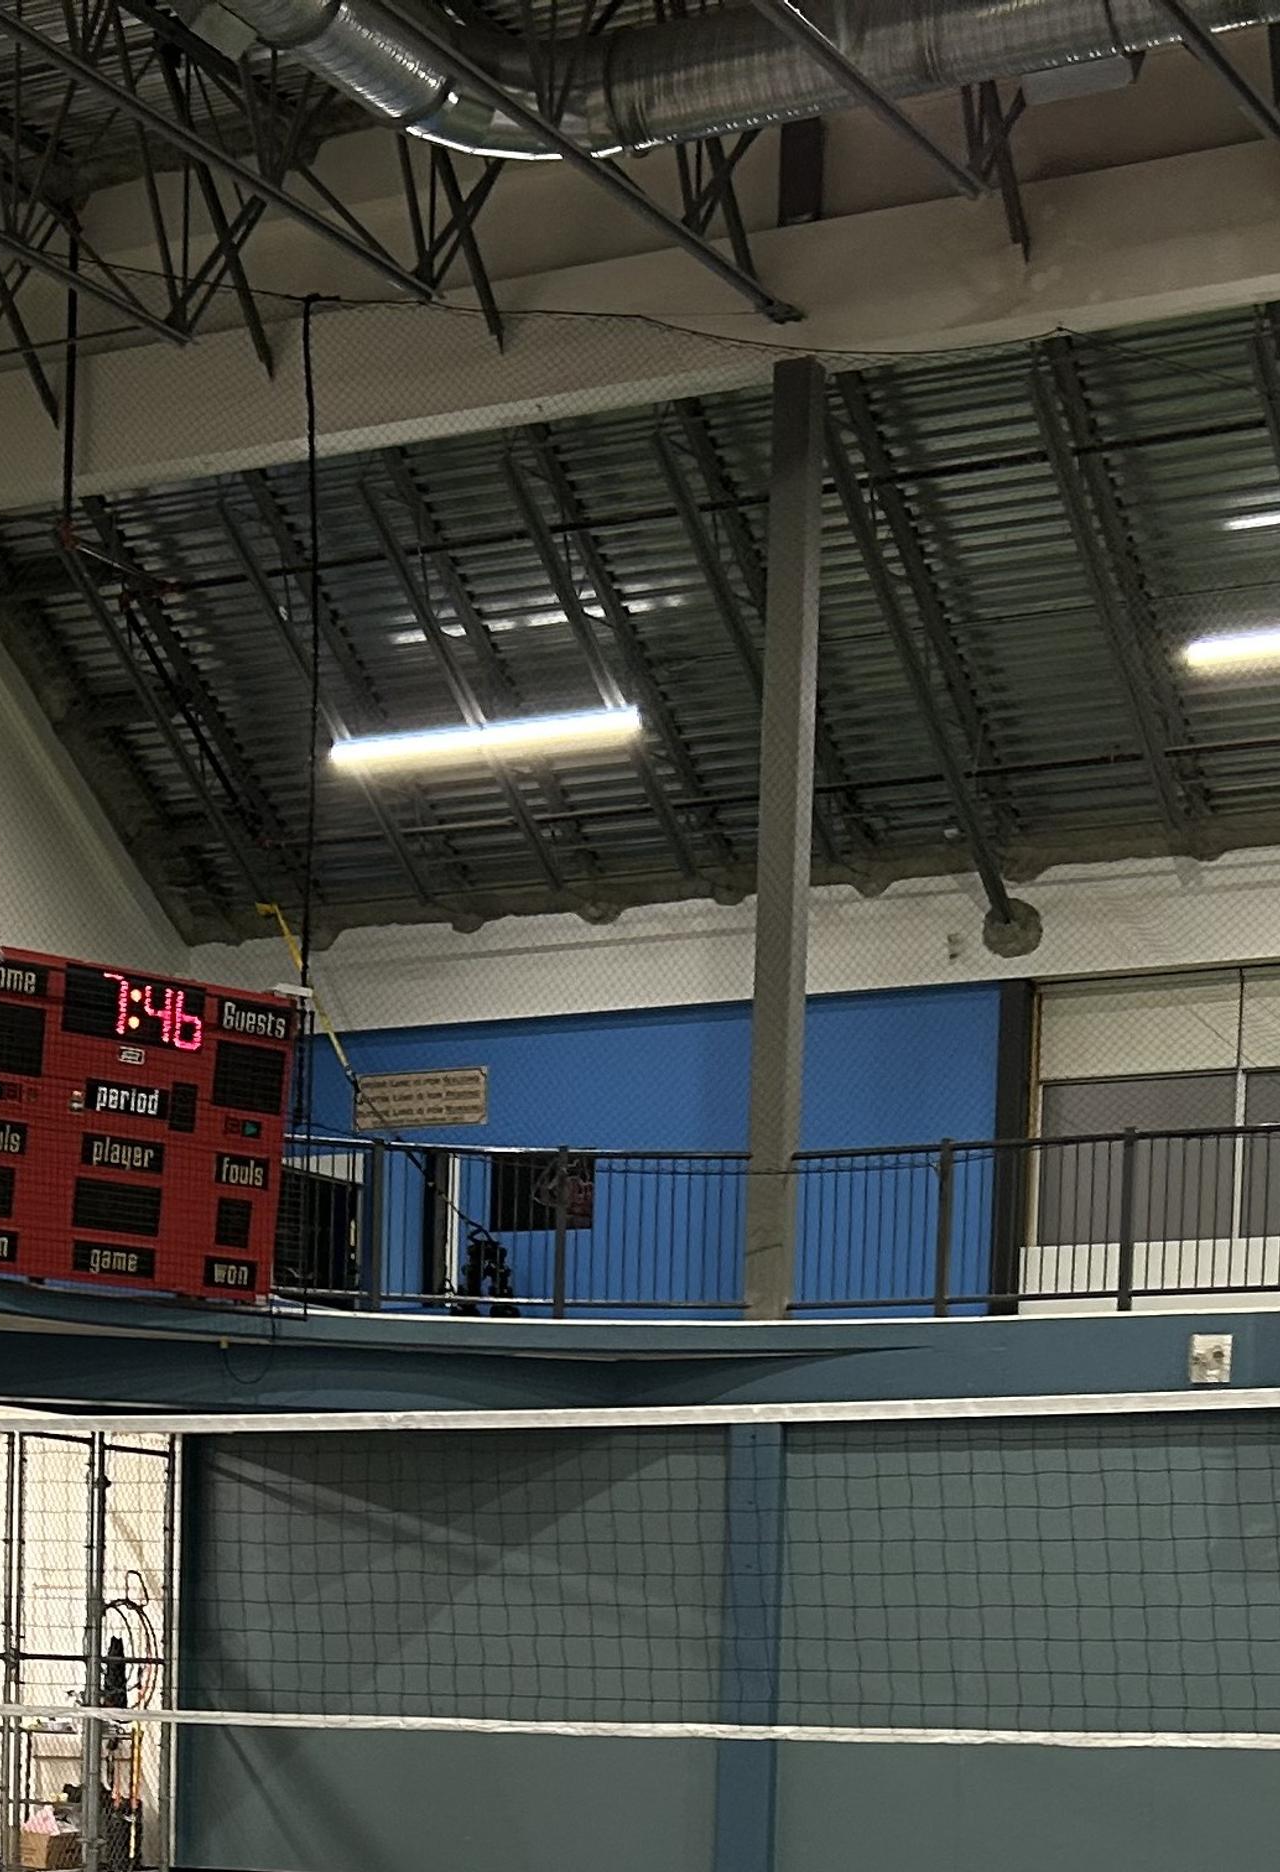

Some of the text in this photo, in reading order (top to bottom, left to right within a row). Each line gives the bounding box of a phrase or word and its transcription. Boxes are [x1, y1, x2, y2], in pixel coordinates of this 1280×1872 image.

[102, 971, 203, 1051] 7:46
[222, 1000, 287, 1040] Guests
[95, 1085, 161, 1116] period
[91, 1136, 155, 1171] player
[221, 1156, 265, 1188] fouls
[89, 1248, 139, 1275] game
[213, 1262, 249, 1286] won
